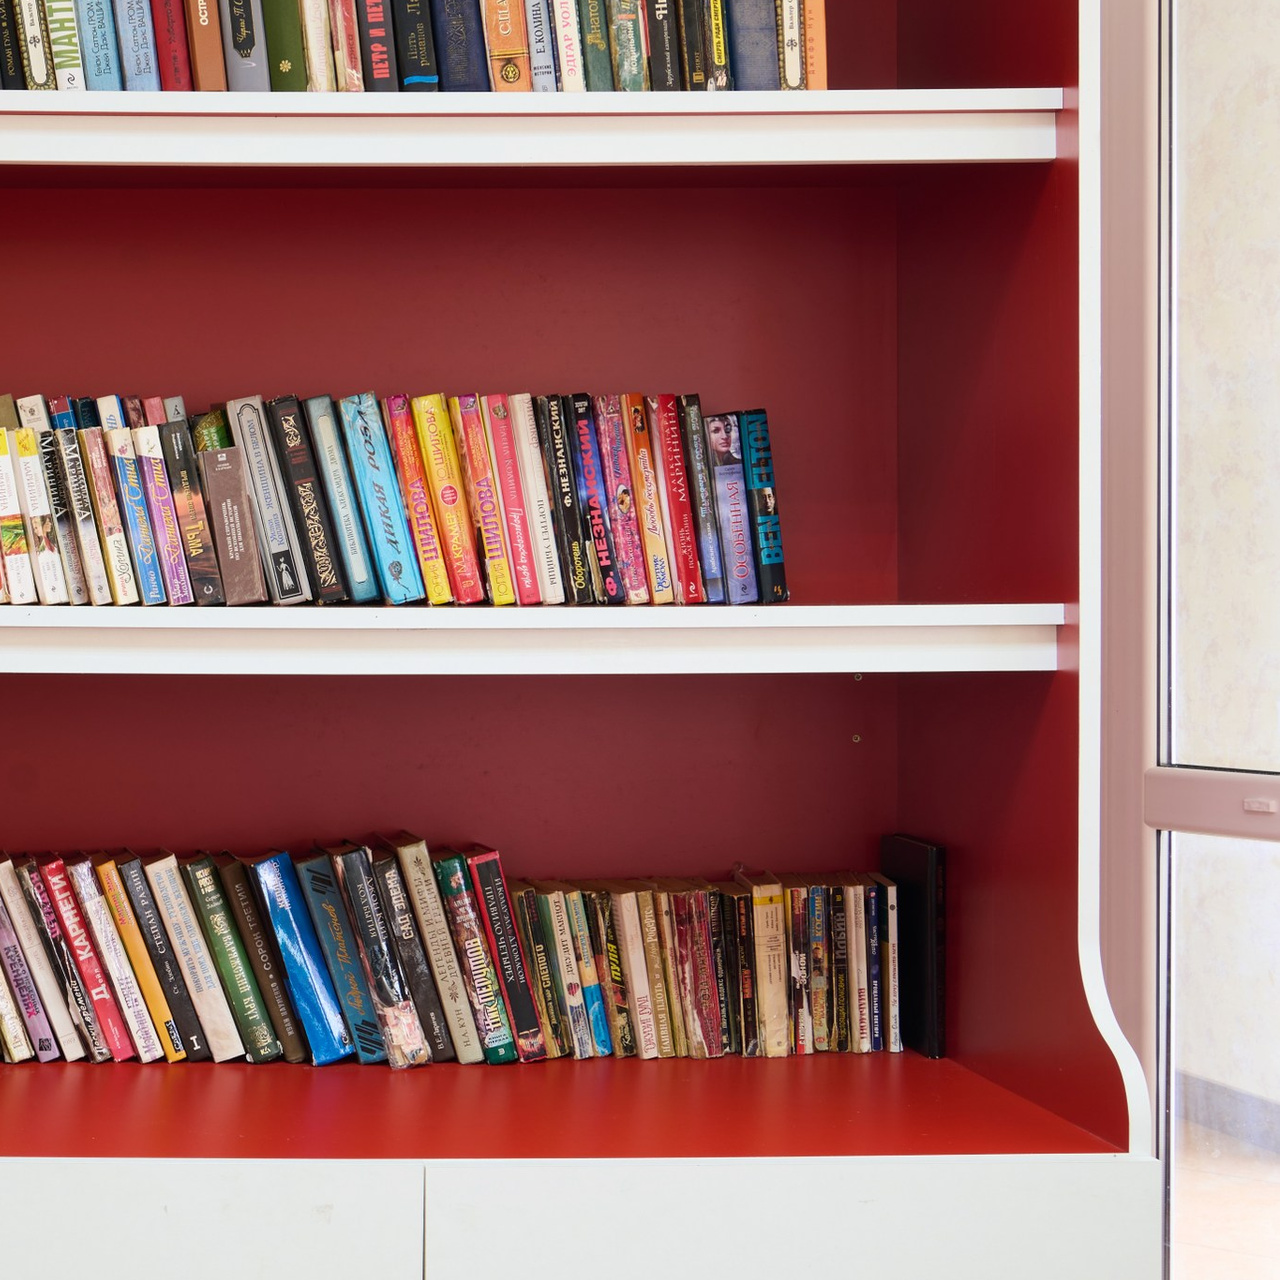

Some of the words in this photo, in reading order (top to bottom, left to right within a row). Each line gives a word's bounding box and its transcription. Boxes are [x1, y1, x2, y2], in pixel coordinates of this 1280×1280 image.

[26, 2, 35, 27] Вальтер
[86, 2, 97, 26] ГРОМ
[126, 0, 137, 25] ГРОМ
[370, 28, 386, 37] И
[531, 2, 545, 42] КОЛИНА
[714, 22, 722, 39] РАДИ
[90, 26, 100, 53] Саттон
[130, 25, 140, 53] Саттон
[407, 32, 418, 60] Пять
[416, 22, 430, 67] романов
[535, 43, 545, 54] Е.
[714, 39, 723, 64] СМЕРТЬ
[371, 42, 390, 78] ПЕТР
[247, 418, 259, 450] БЕЛОМ
[327, 444, 339, 465] ДЮМА
[662, 412, 678, 493] АЛЕКСАНДРА
[667, 400, 687, 502] МАРИНИНА
[745, 414, 775, 489] ELTON
[64, 443, 90, 521] МАРИНИНА
[258, 459, 273, 509] ЖЕНЩИНА
[334, 469, 348, 510] АЛЕКСАНДРА
[576, 419, 609, 567] НЕЗНАНСКИЙ
[344, 512, 359, 555] БИБЛИОТЕКА
[372, 481, 401, 555] ДИКАЯ
[475, 476, 505, 560] ШИЛОВА
[726, 481, 750, 579] ОСОБЕННАЯ
[536, 499, 550, 542] ПОРТРЕТ
[544, 545, 557, 585] УБИЙЦЫ
[678, 527, 688, 555] ЖИЗНЬ
[757, 514, 784, 565] BEN
[572, 541, 585, 589] Оборотень
[604, 570, 618, 596] Ф.
[356, 883, 368, 903] КОД
[362, 904, 376, 938] БЫТИЯ
[413, 877, 430, 915] МИФЫ
[424, 878, 445, 924] ГРЕЦИИ
[435, 926, 458, 979] ДРЕВНЕЙ
[484, 886, 501, 935] ПРАВИЛО
[497, 936, 515, 983] ЧЕТЫРЕХ
[427, 929, 448, 983] ЛЕГЕНДЫ
[536, 944, 552, 987] СЛЕПОГО
[606, 943, 622, 981] ПУЛЯ
[654, 983, 666, 1011] ПЛОТЬ
[659, 1012, 671, 1053] НАИВНАЯ
